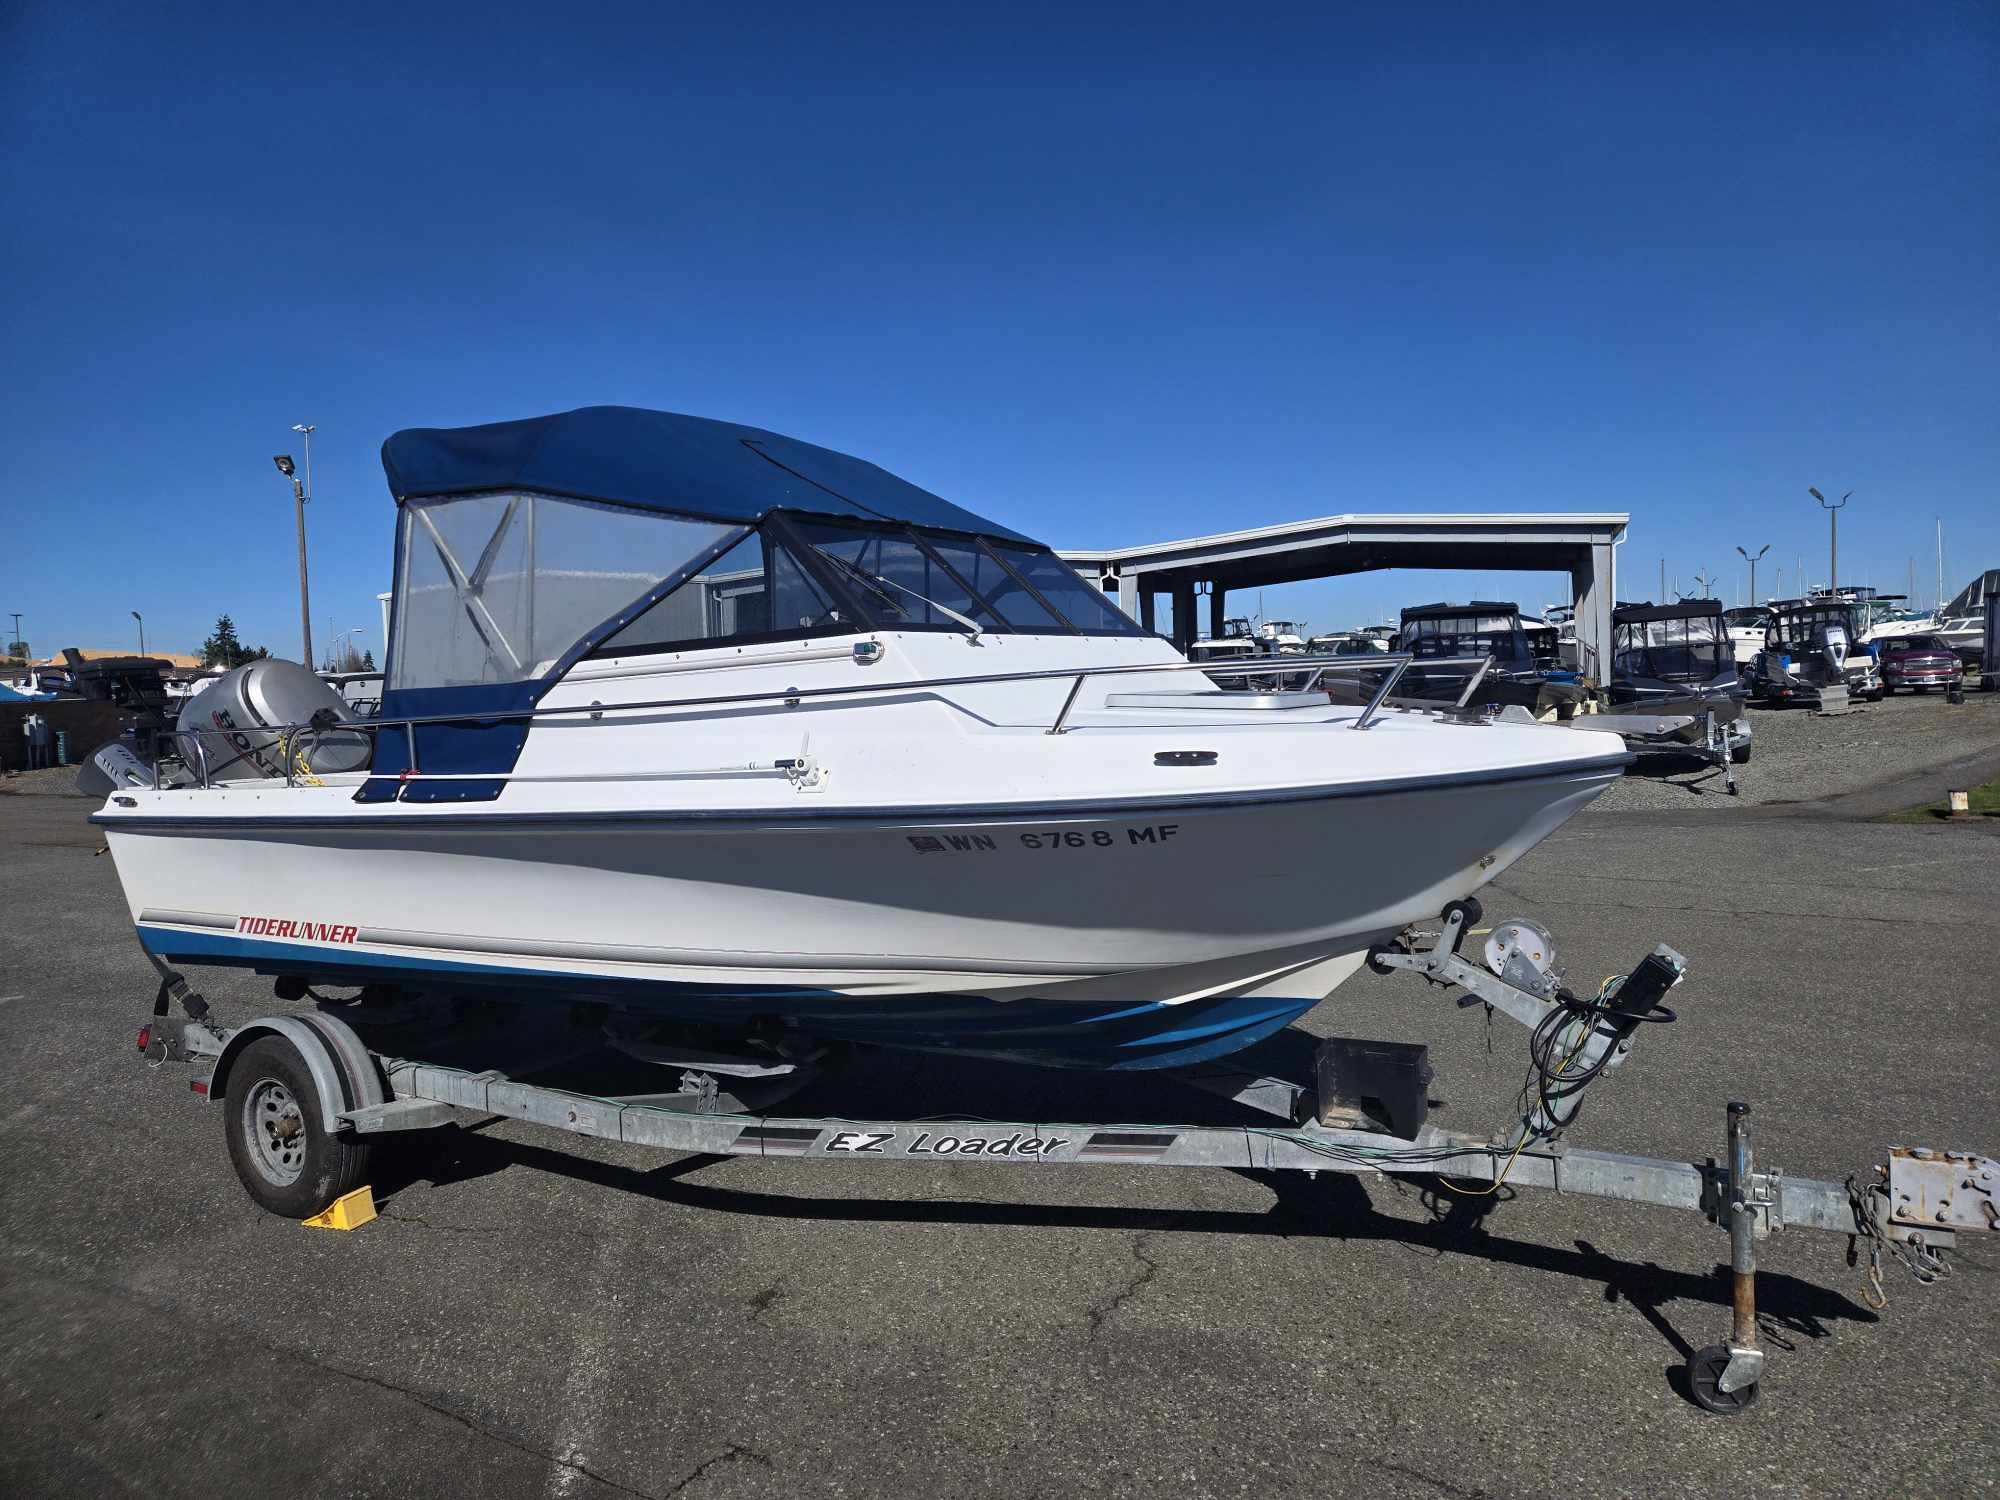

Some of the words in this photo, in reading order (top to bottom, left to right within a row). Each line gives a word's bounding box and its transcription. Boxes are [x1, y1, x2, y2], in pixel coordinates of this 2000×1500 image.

[219, 708, 288, 778] HOND
[944, 834, 997, 851] WN
[1020, 831, 1113, 849] 6768
[1128, 825, 1179, 845] MF
[239, 916, 358, 944] TIDERUNNER
[825, 1131, 896, 1153] EZ
[906, 1132, 1071, 1157] Loader
